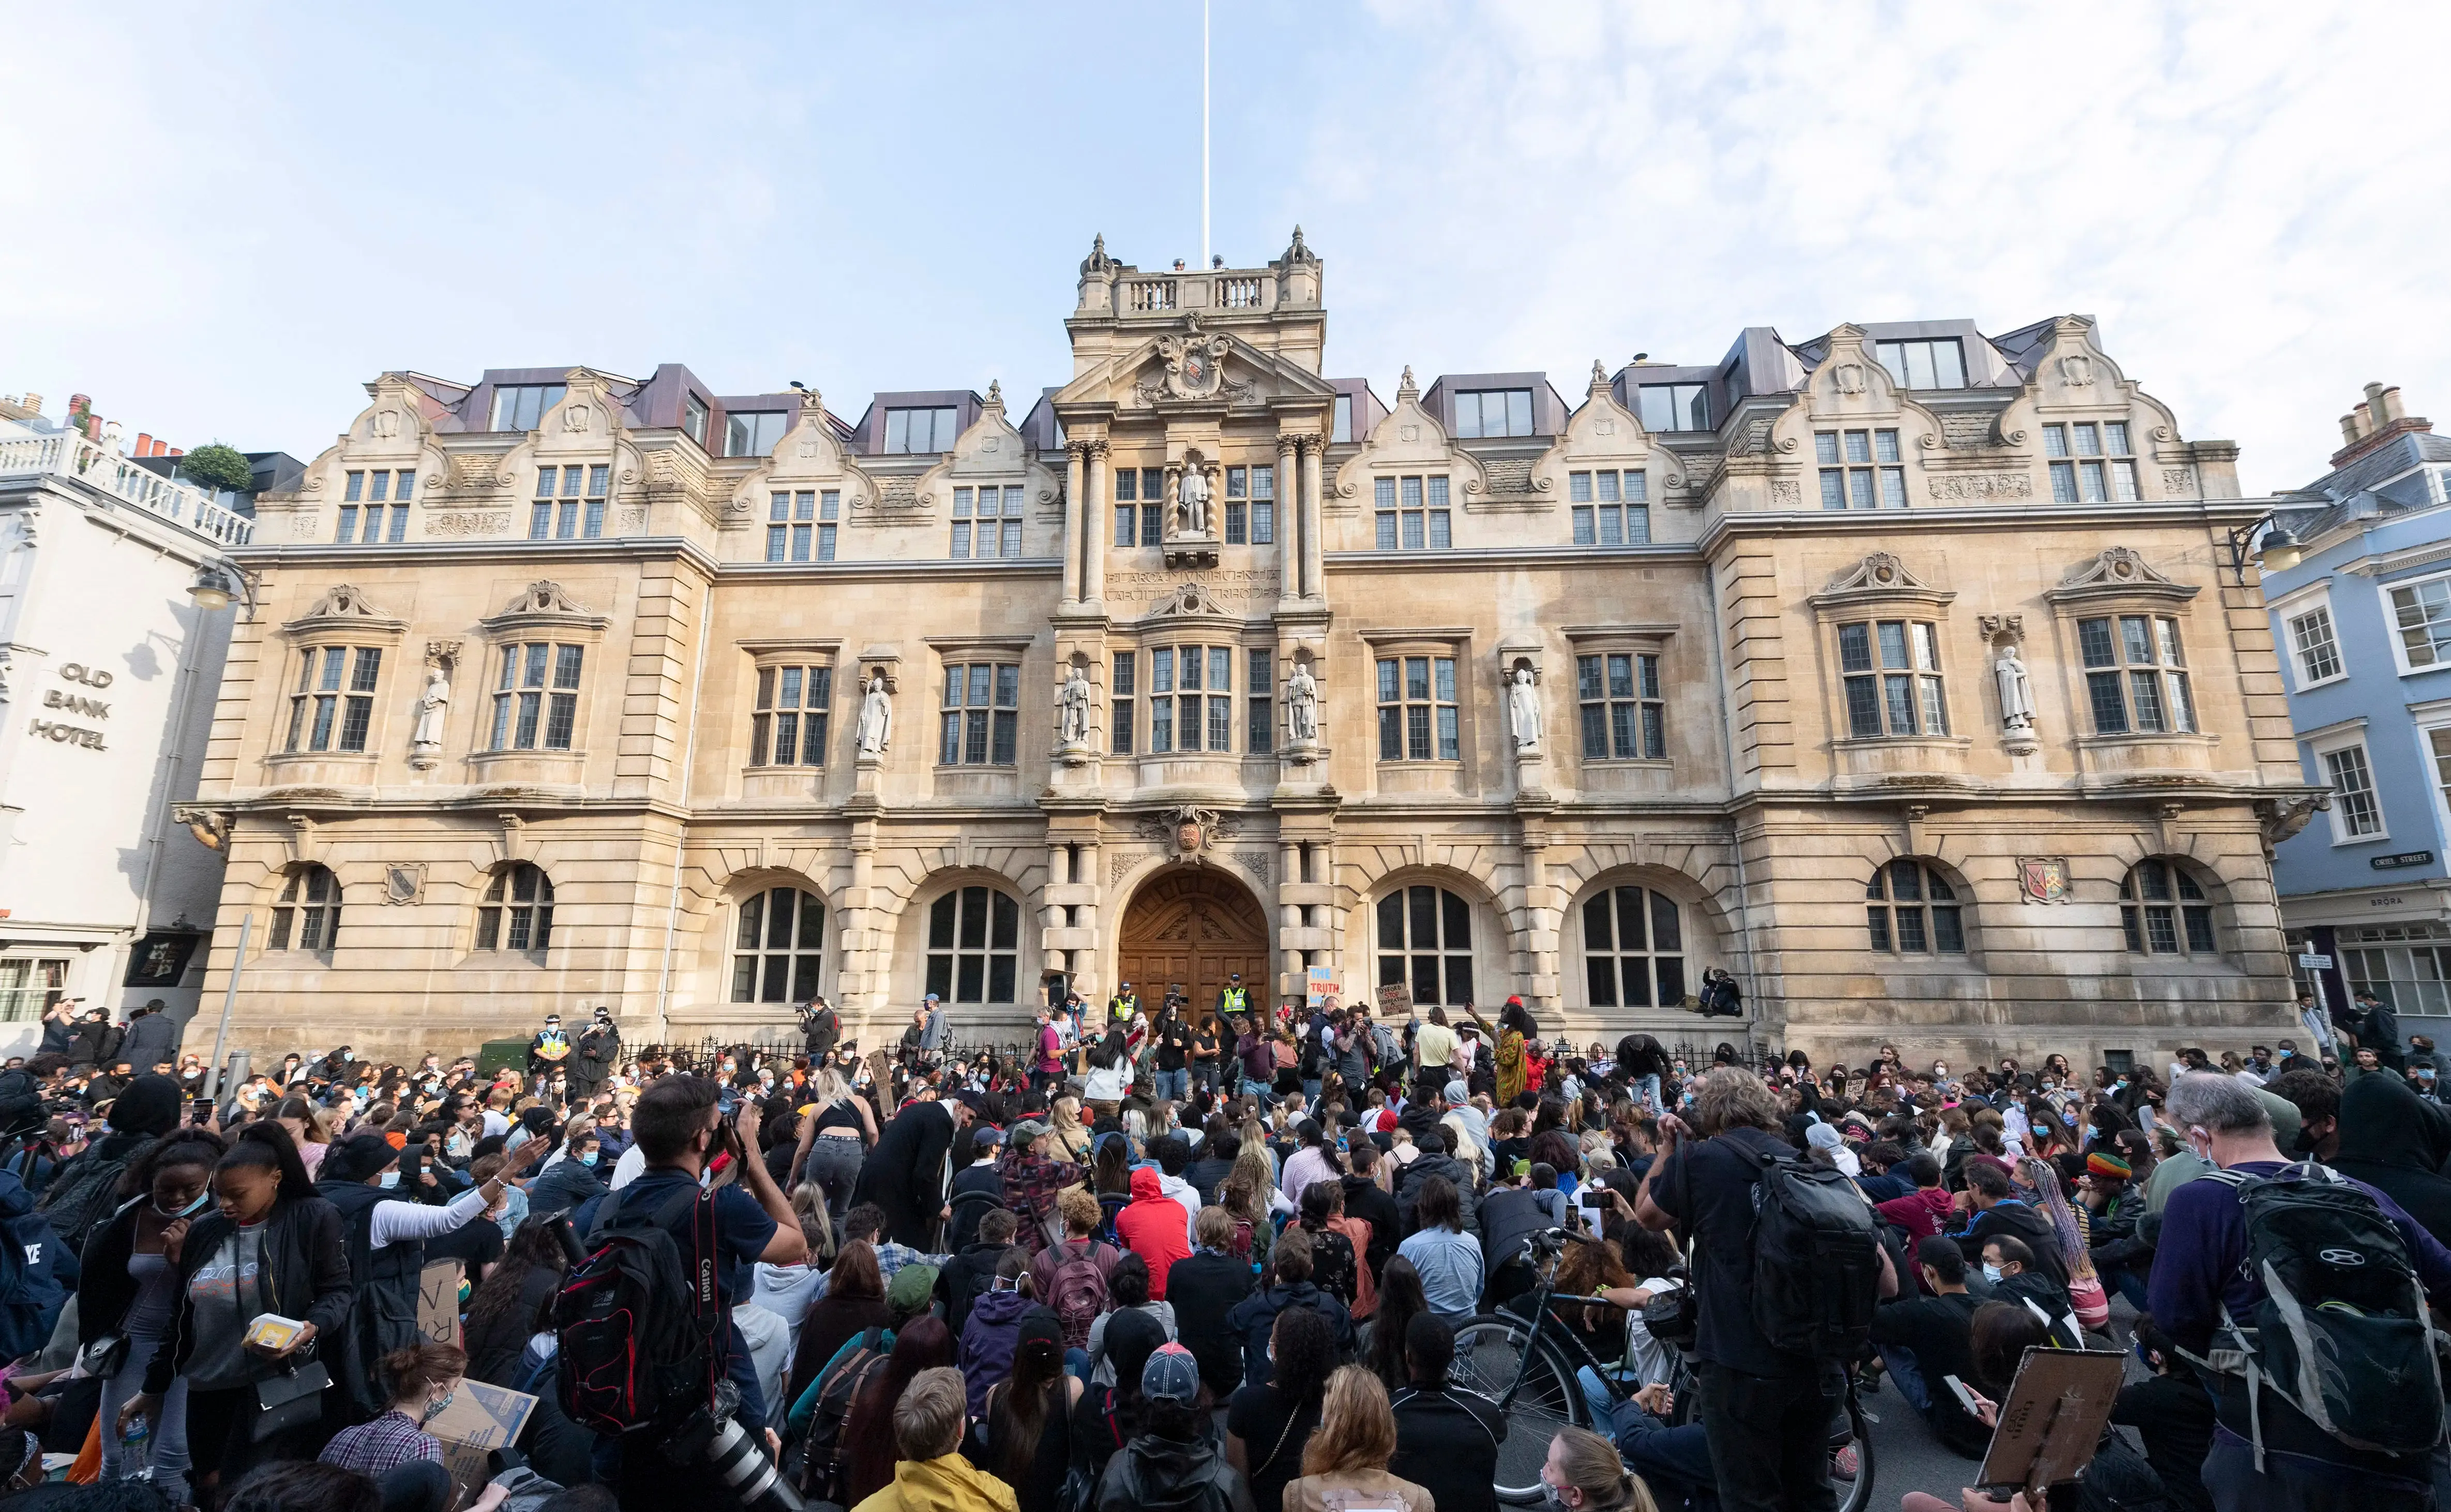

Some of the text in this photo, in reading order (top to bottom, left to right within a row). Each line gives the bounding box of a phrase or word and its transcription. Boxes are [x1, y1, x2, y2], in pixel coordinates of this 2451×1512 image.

[1221, 585, 1280, 599] RHODES
[59, 663, 113, 688] OLD
[43, 690, 112, 721] BANK
[29, 718, 109, 751] HOTEL
[2375, 854, 2427, 866] ORIEL STREET
[1310, 968, 1330, 979] THE
[1311, 982, 1340, 993] TRUTH
[1379, 985, 1401, 994] OXFORD
[1378, 996, 1407, 1005] CELEBRATING
[701, 1259, 712, 1302] Canon
